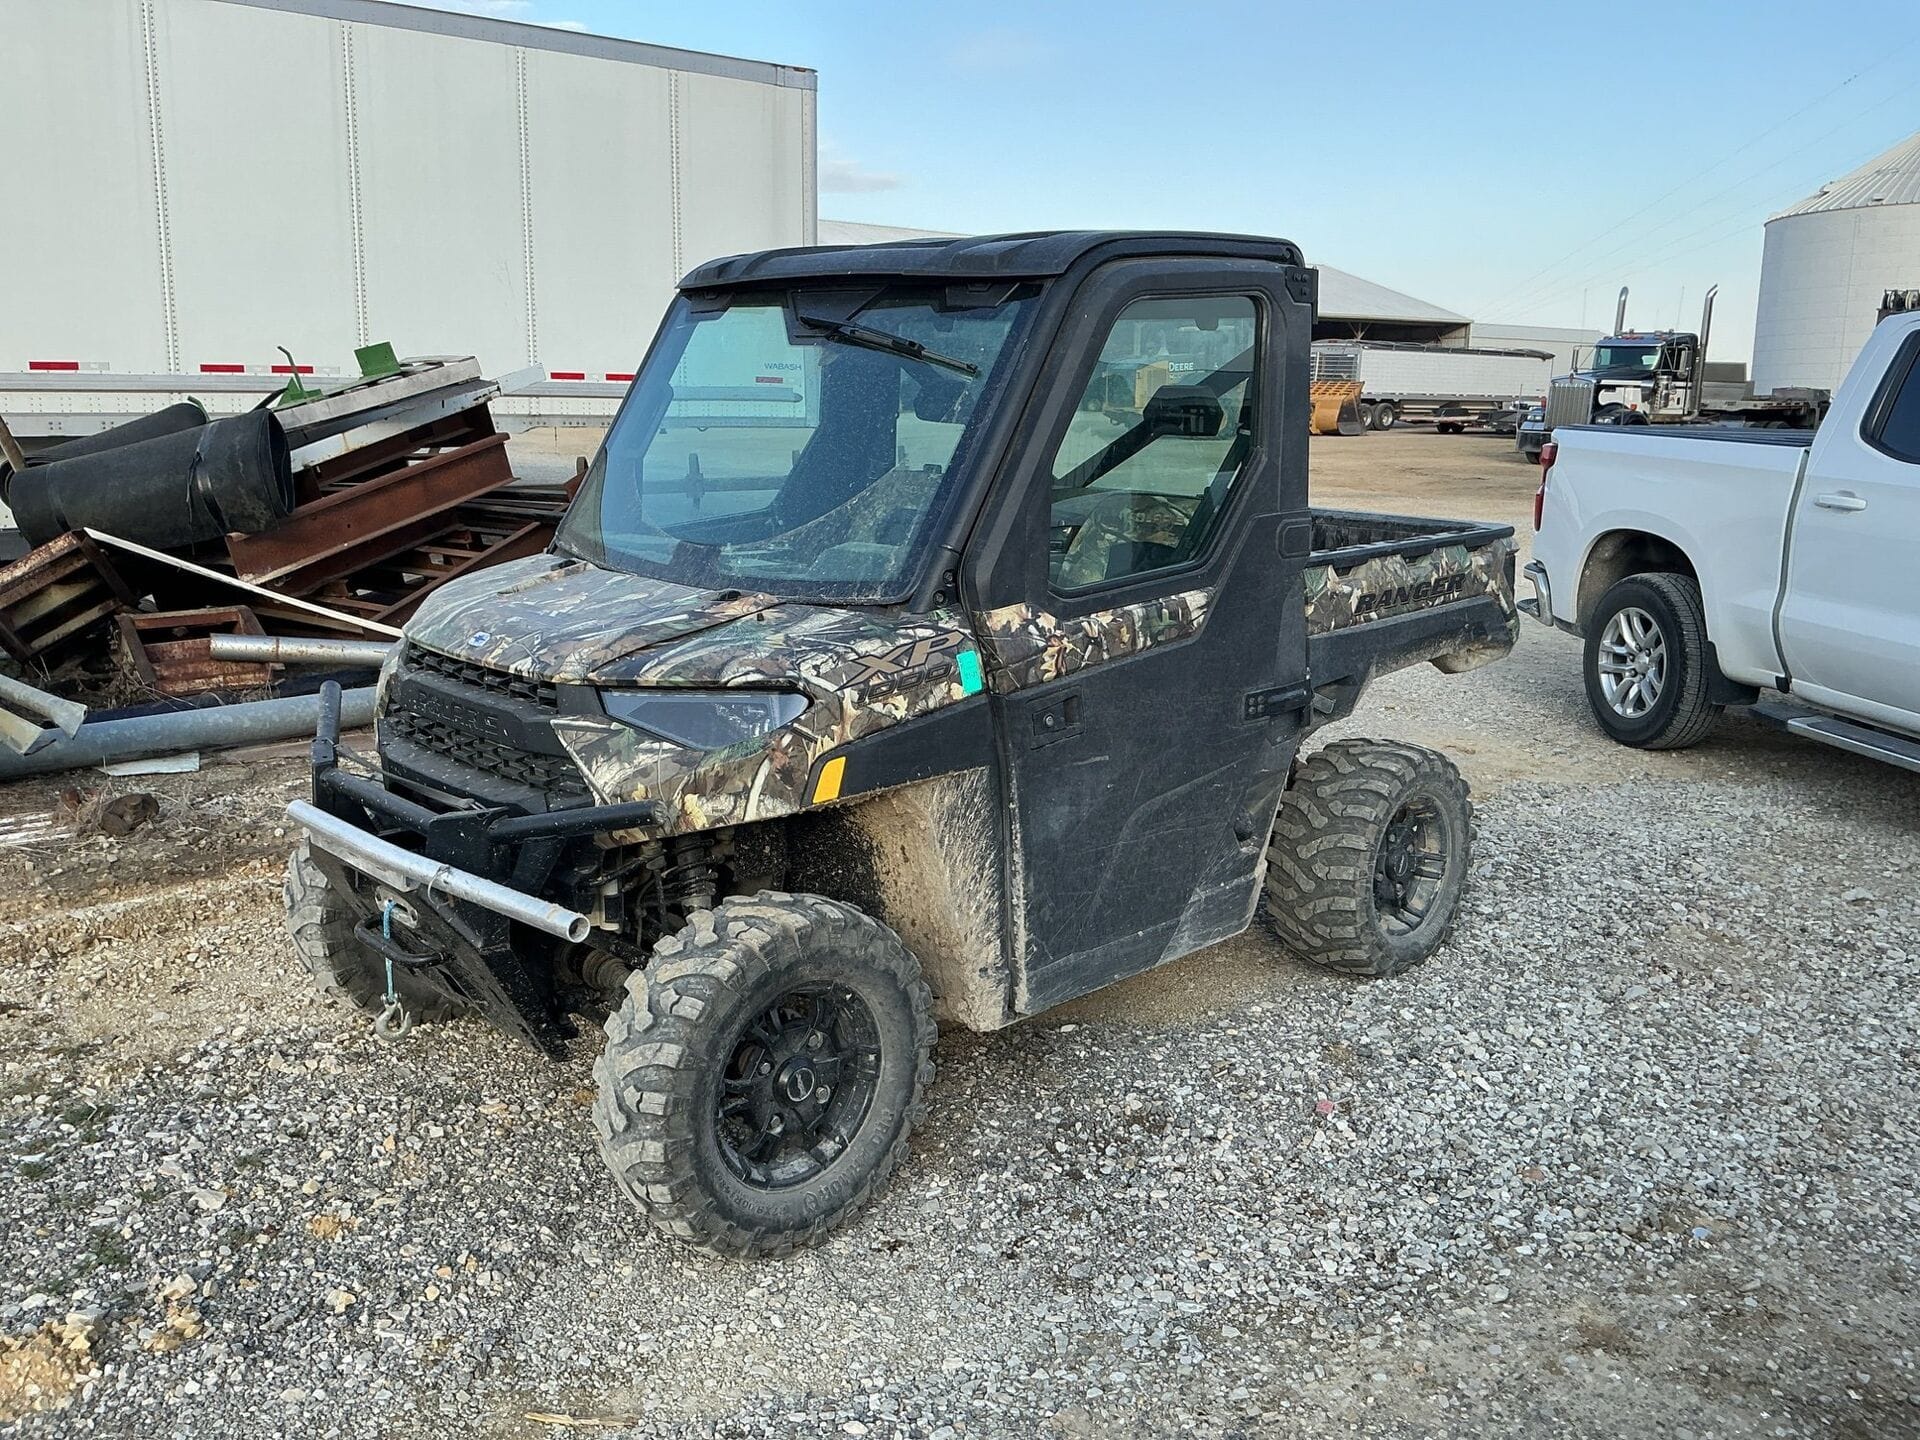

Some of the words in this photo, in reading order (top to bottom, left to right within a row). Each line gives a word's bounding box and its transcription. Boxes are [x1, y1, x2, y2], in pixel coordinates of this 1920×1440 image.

[764, 362, 802, 371] WABASH
[1168, 361, 1194, 372] DEERE
[1354, 572, 1468, 617] RANGER
[834, 629, 966, 692] XP
[857, 663, 954, 703] 1000
